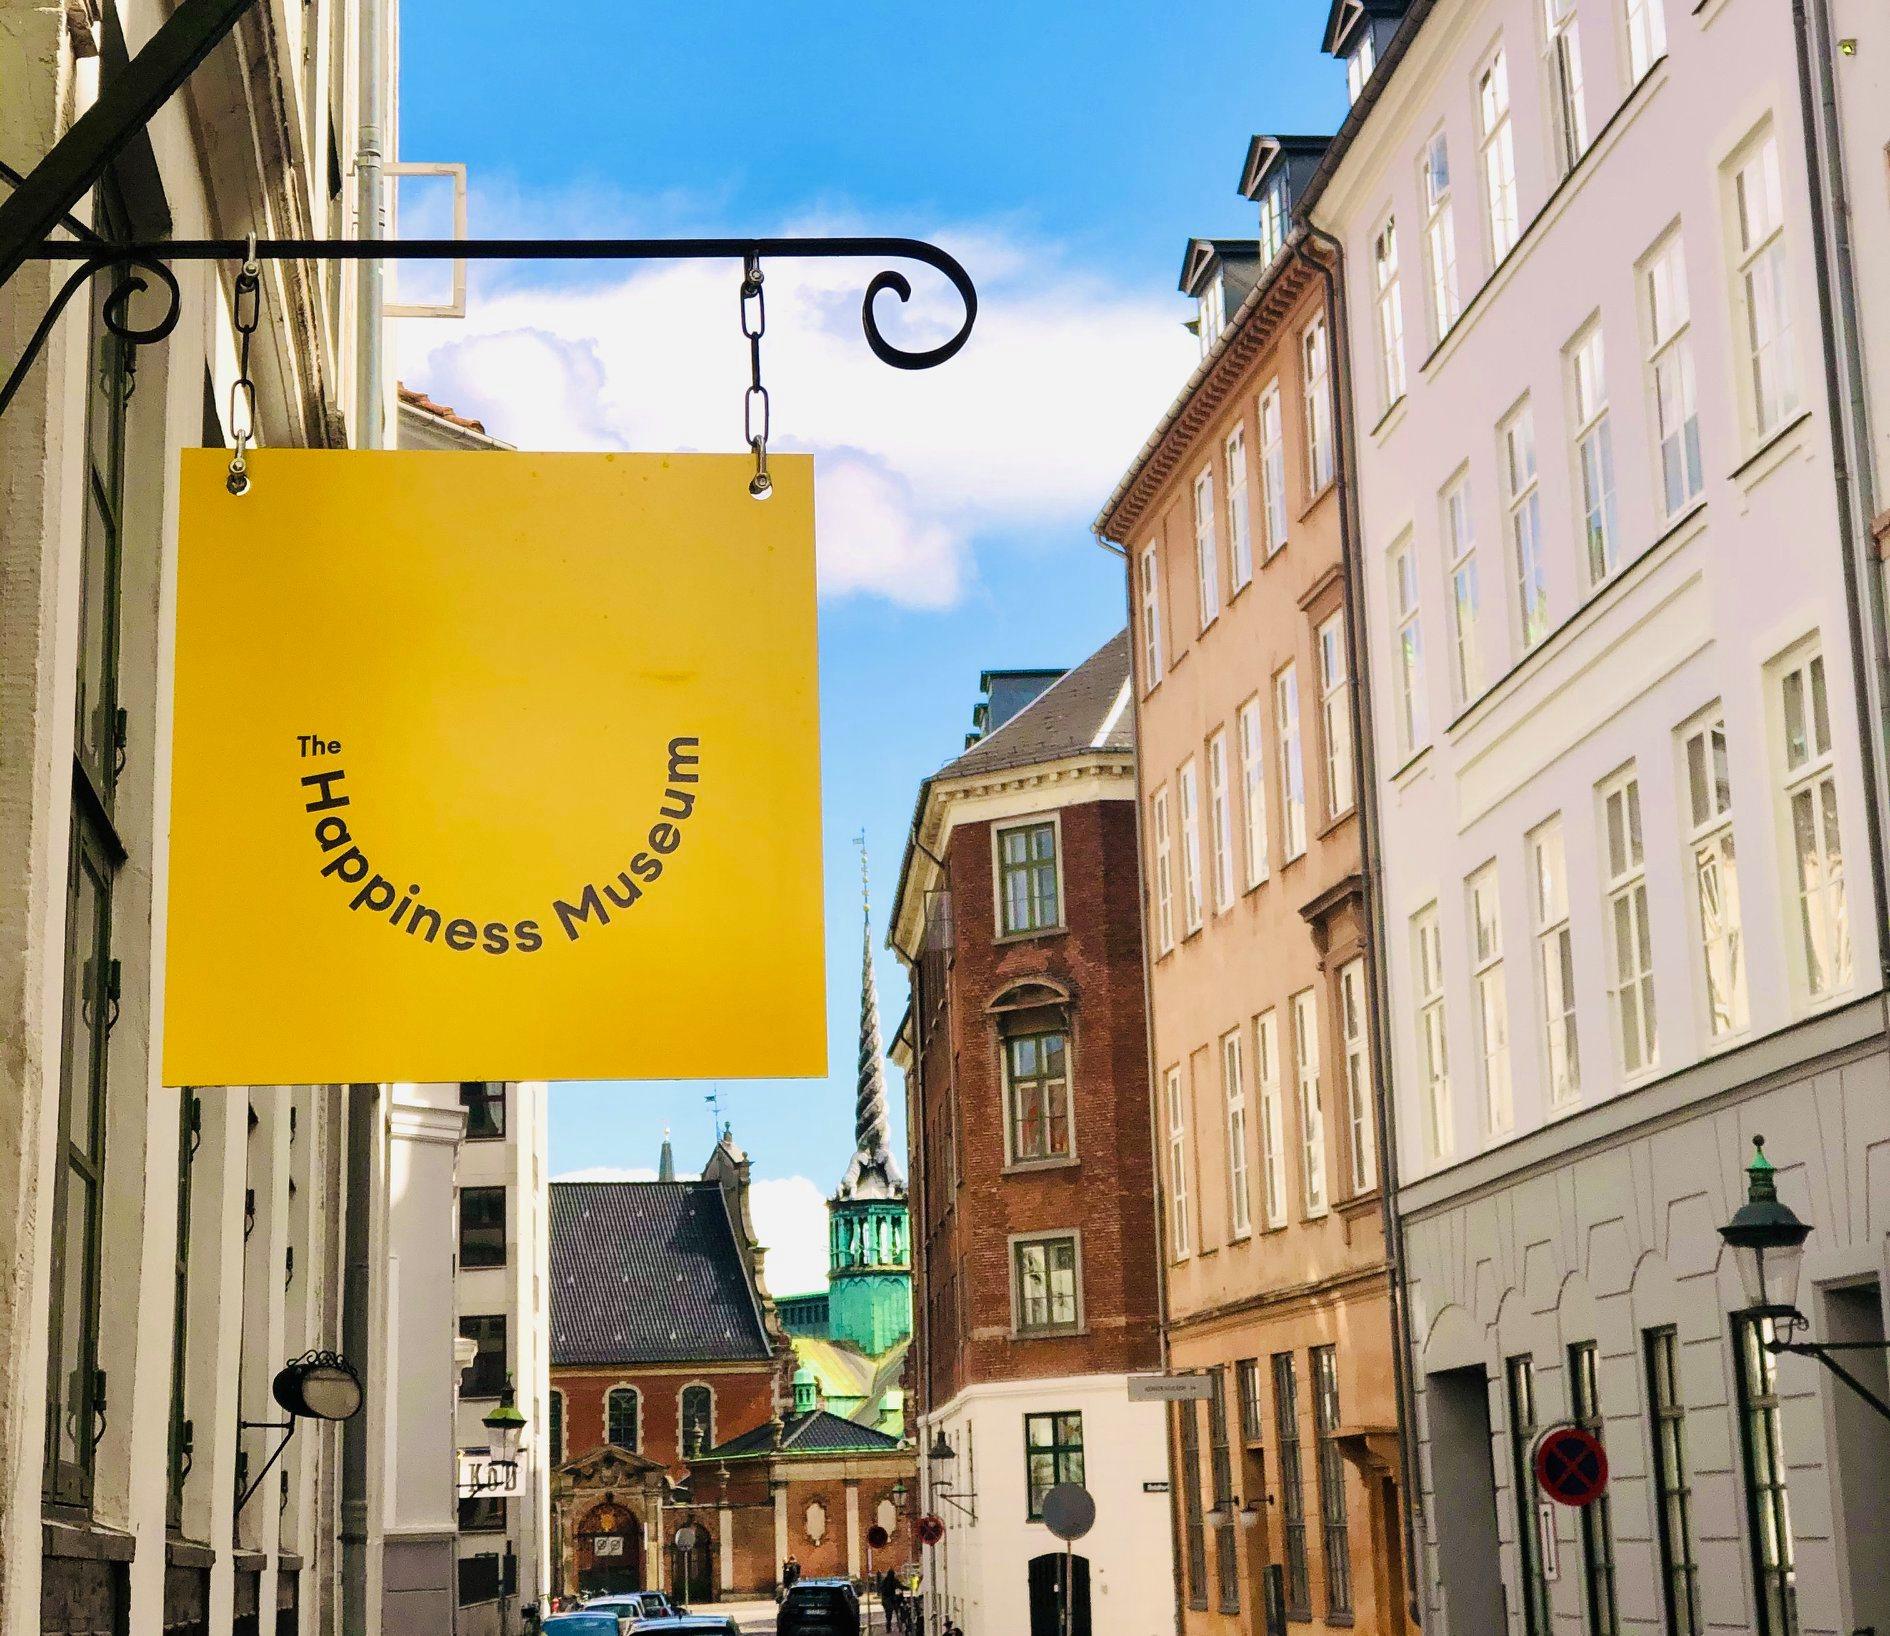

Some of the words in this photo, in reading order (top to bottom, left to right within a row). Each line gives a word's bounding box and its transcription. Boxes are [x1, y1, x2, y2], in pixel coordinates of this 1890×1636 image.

[296, 734, 342, 758] The
[301, 769, 543, 955] Happiness
[553, 736, 700, 942] Museum
